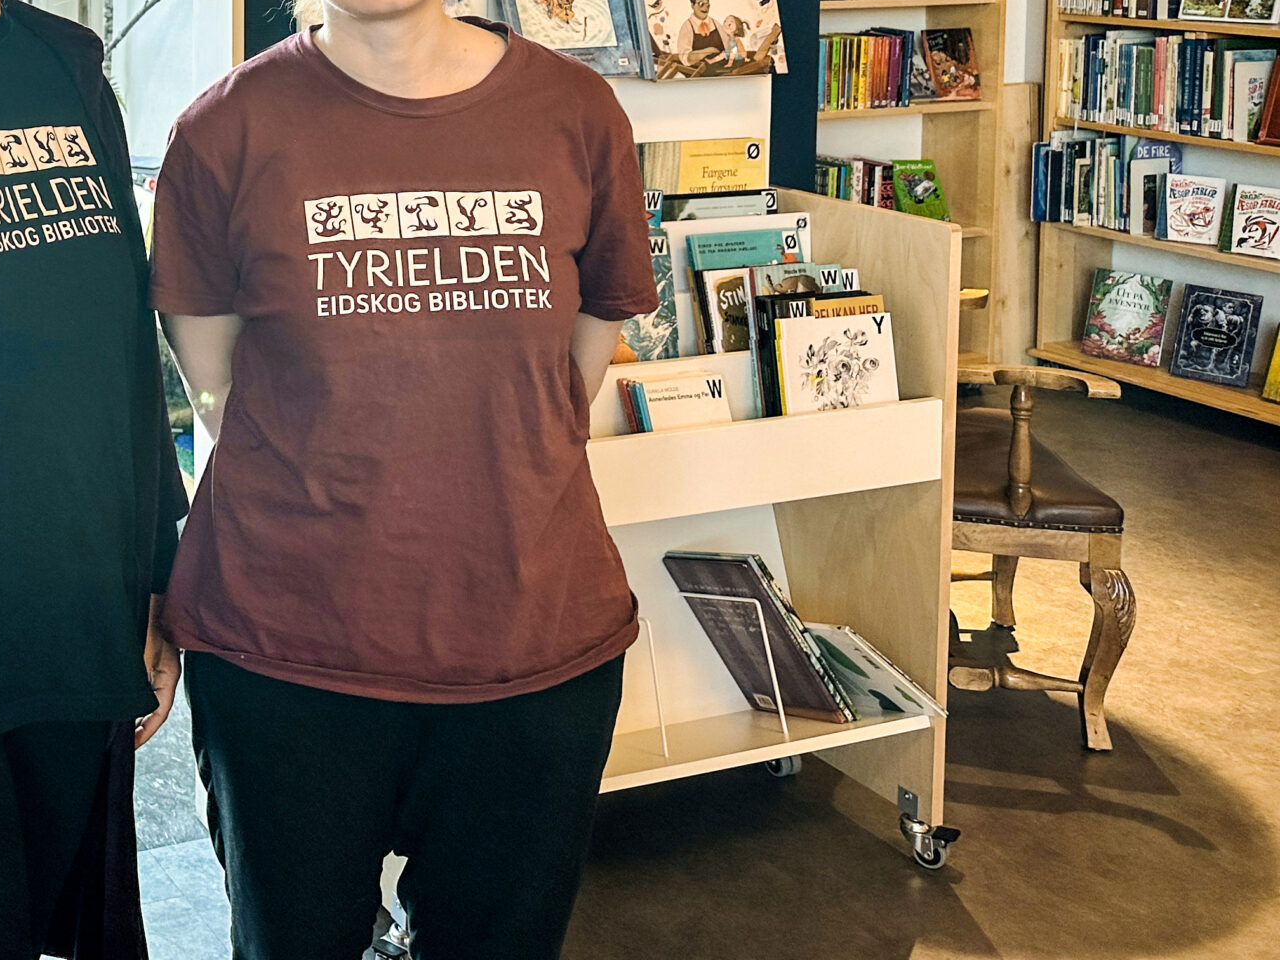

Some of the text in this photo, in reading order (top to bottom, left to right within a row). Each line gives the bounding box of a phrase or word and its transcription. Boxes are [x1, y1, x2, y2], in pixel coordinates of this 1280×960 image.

[747, 143, 760, 160] Ø
[1137, 146, 1149, 158] DE
[702, 166, 738, 179] Fargene
[647, 192, 661, 209] W
[41, 215, 121, 243] BIBLIOTEK
[650, 239, 665, 254] W
[785, 234, 797, 250] Ø
[308, 245, 550, 290] TYRIELDEN
[821, 270, 837, 285] W
[841, 272, 853, 290] W
[317, 289, 552, 317] EIDSKOG BIBLIOTEK
[790, 302, 804, 318] W
[872, 316, 884, 334] Y
[706, 379, 722, 399] W
